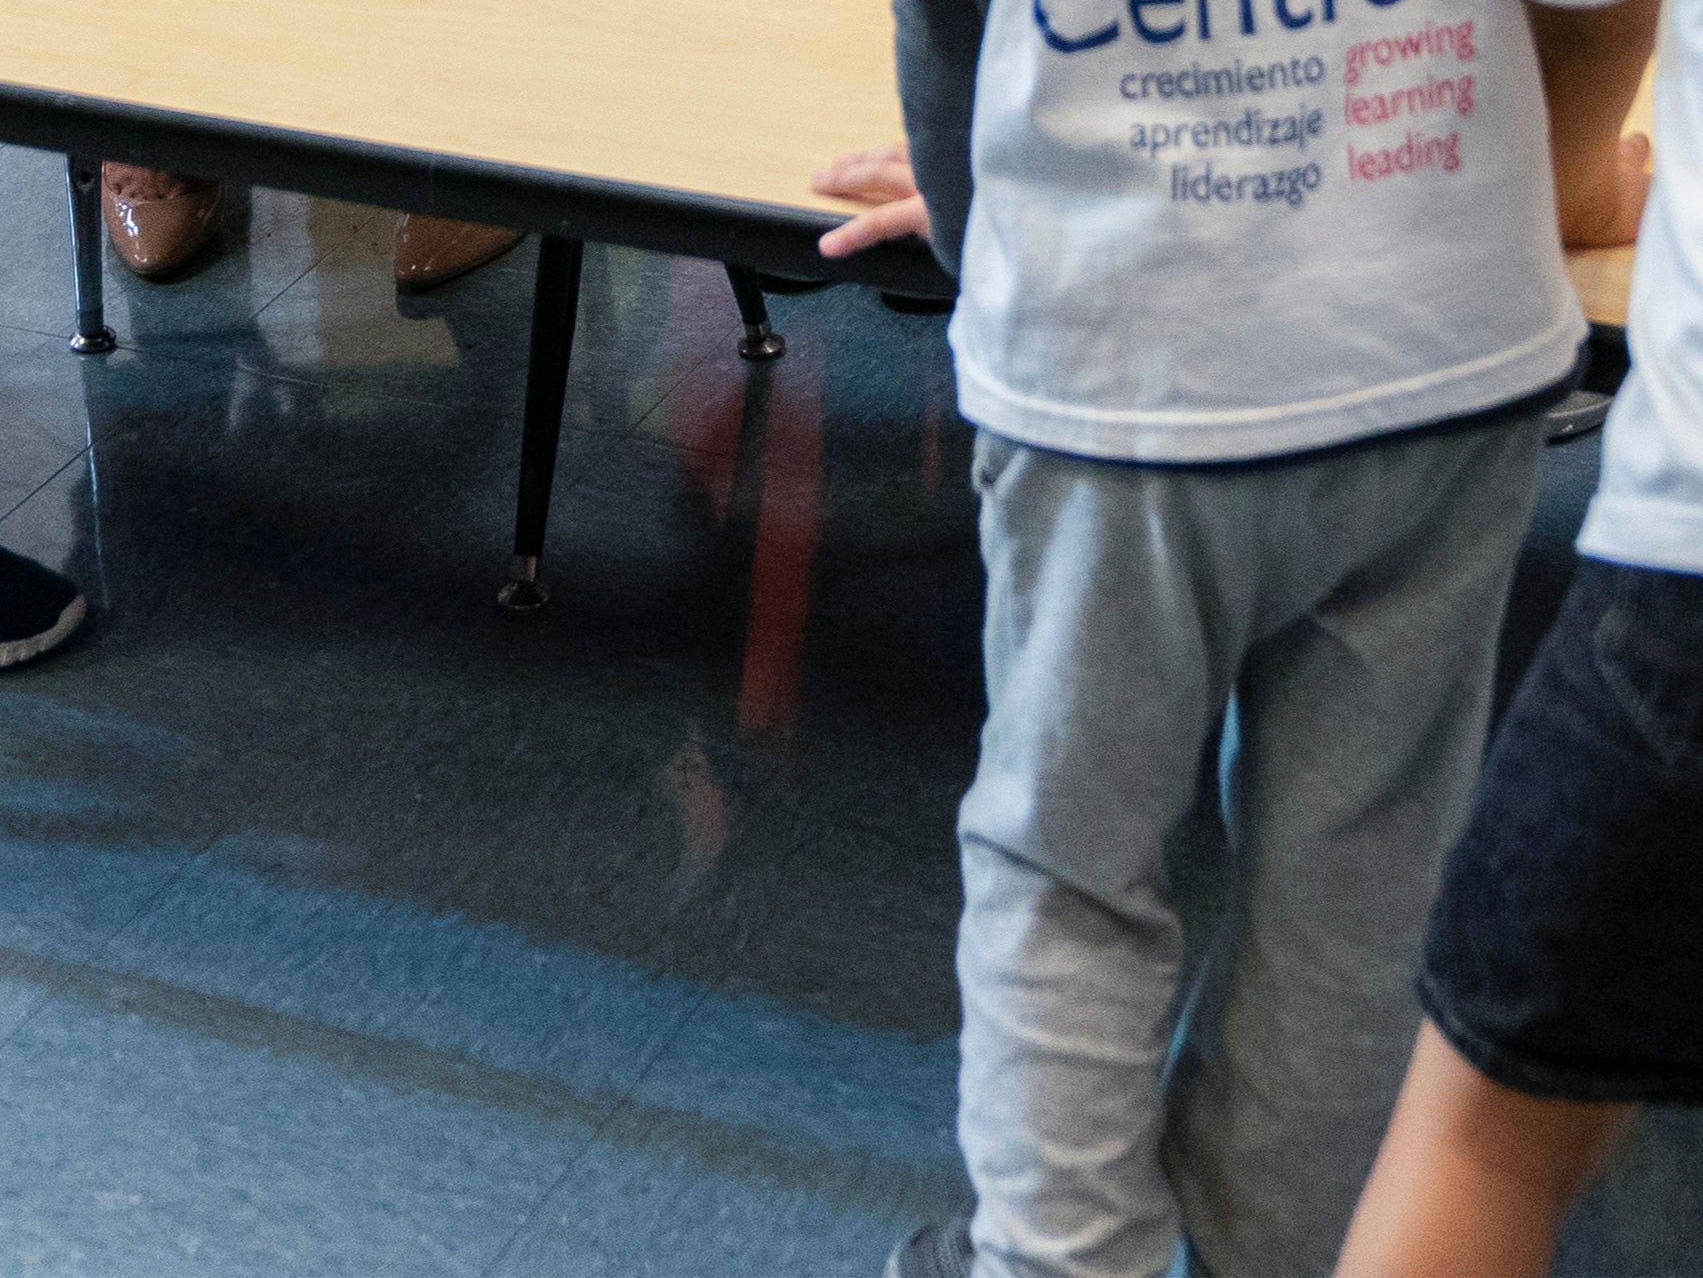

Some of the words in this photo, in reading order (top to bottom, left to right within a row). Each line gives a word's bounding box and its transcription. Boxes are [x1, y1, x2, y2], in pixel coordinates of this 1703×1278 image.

[1119, 53, 1326, 101] crecimiento
[1342, 18, 1478, 86] growing
[1129, 103, 1325, 154] aprendizaje
[1343, 72, 1476, 127] learning
[1170, 161, 1323, 209] liderazgo
[1347, 129, 1463, 182] leading
